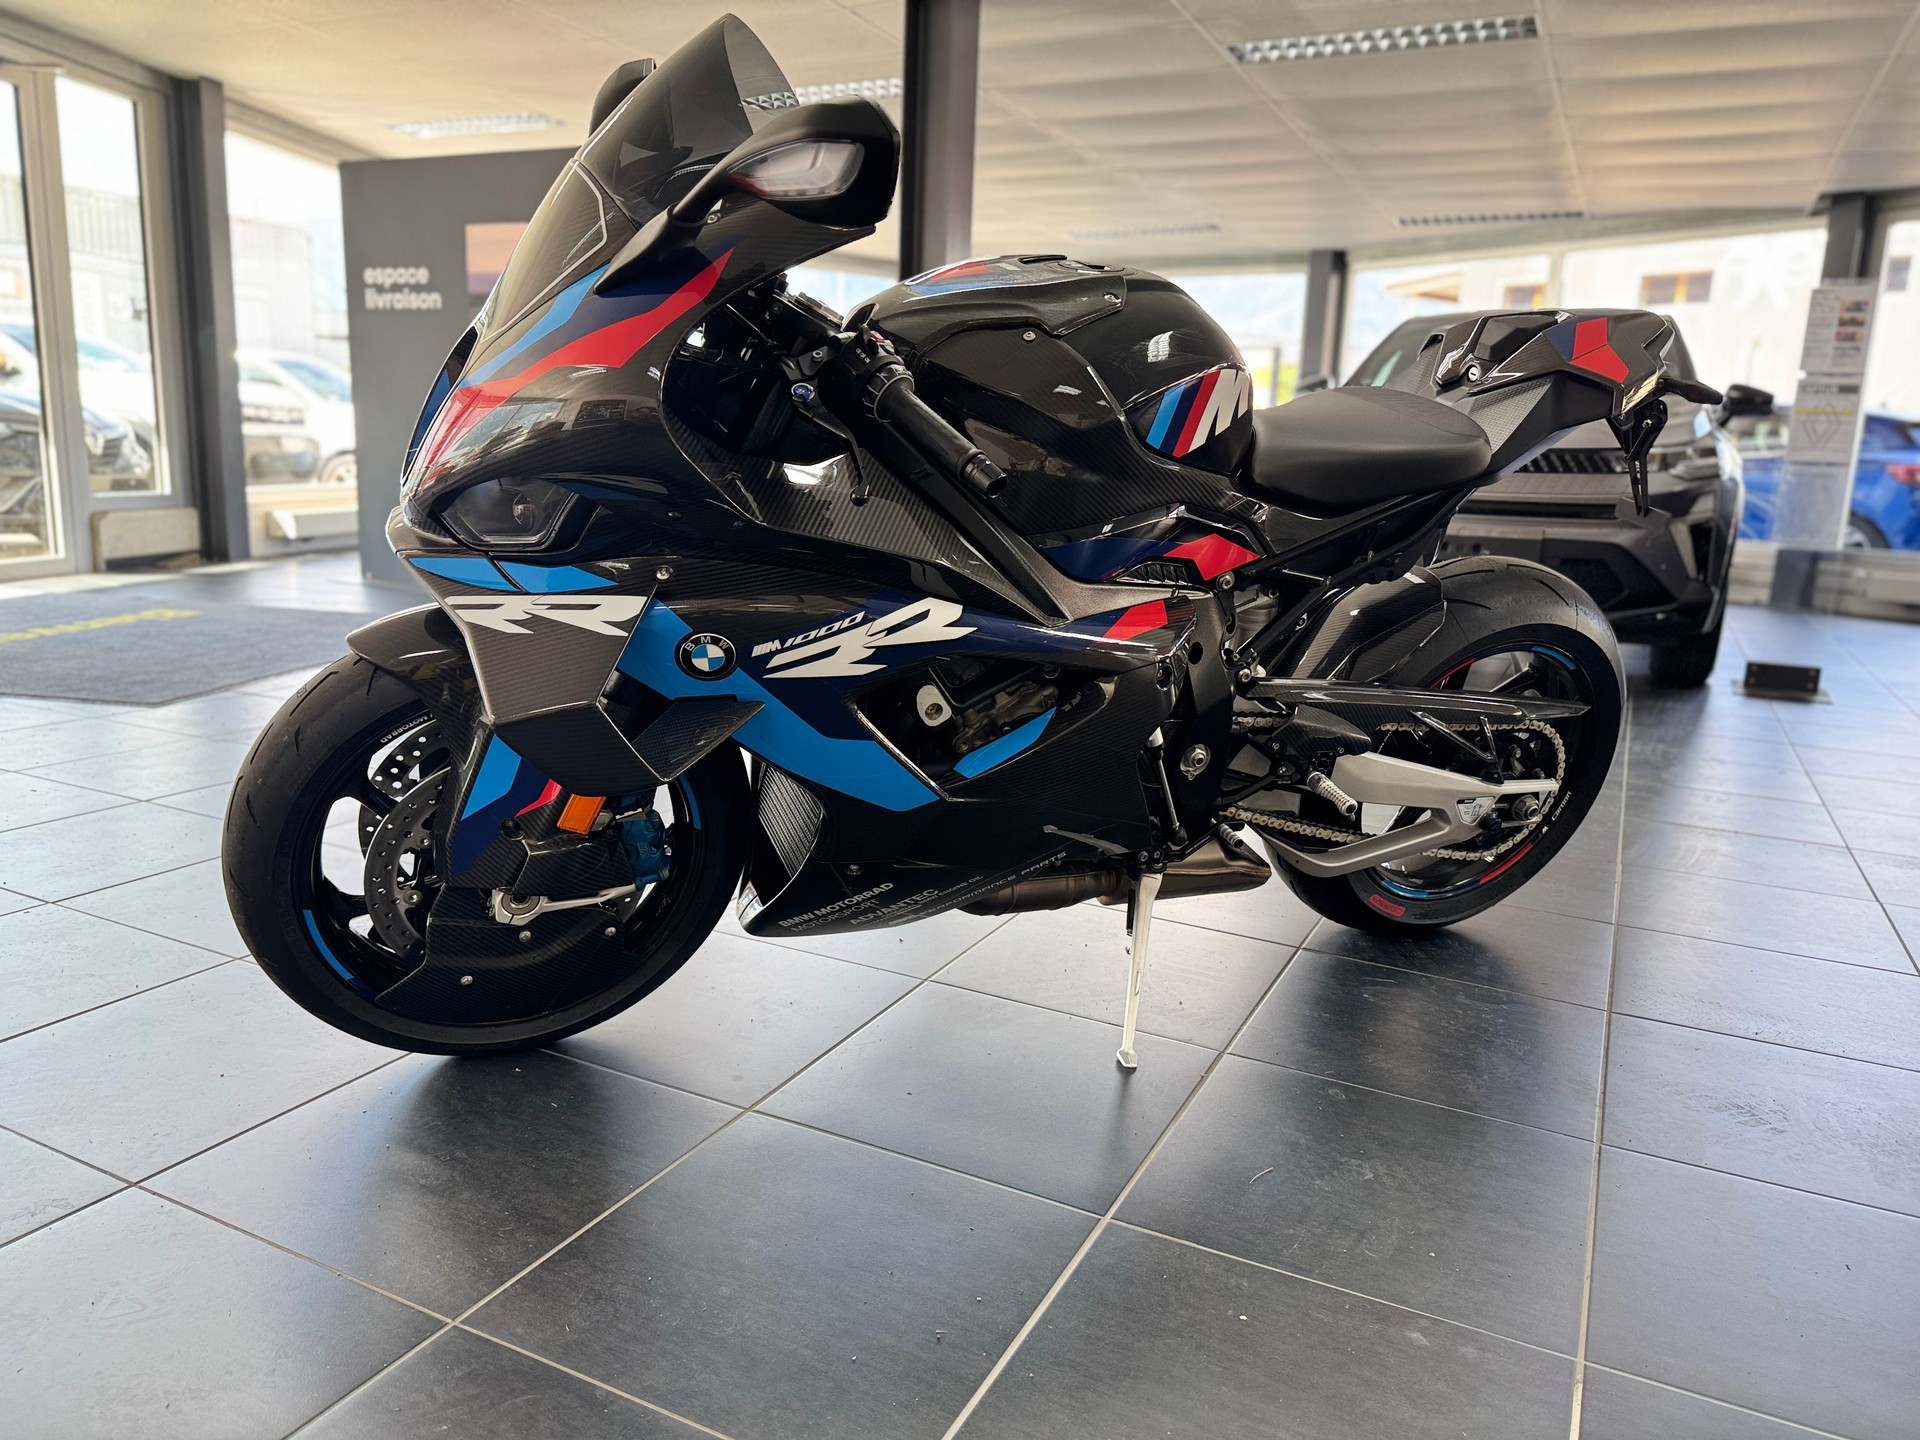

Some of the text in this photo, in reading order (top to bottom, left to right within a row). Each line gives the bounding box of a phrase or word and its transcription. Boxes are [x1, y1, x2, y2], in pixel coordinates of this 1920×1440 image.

[363, 266, 429, 290] espace
[364, 287, 442, 310] livraison
[684, 635, 730, 652] BMW
[1021, 851, 1066, 875] PARTS
[778, 912, 815, 927] BMW
[813, 882, 894, 916] MOTORRAD
[791, 899, 879, 932] MOTORSPORT
[850, 889, 939, 925] ADVANTEC
